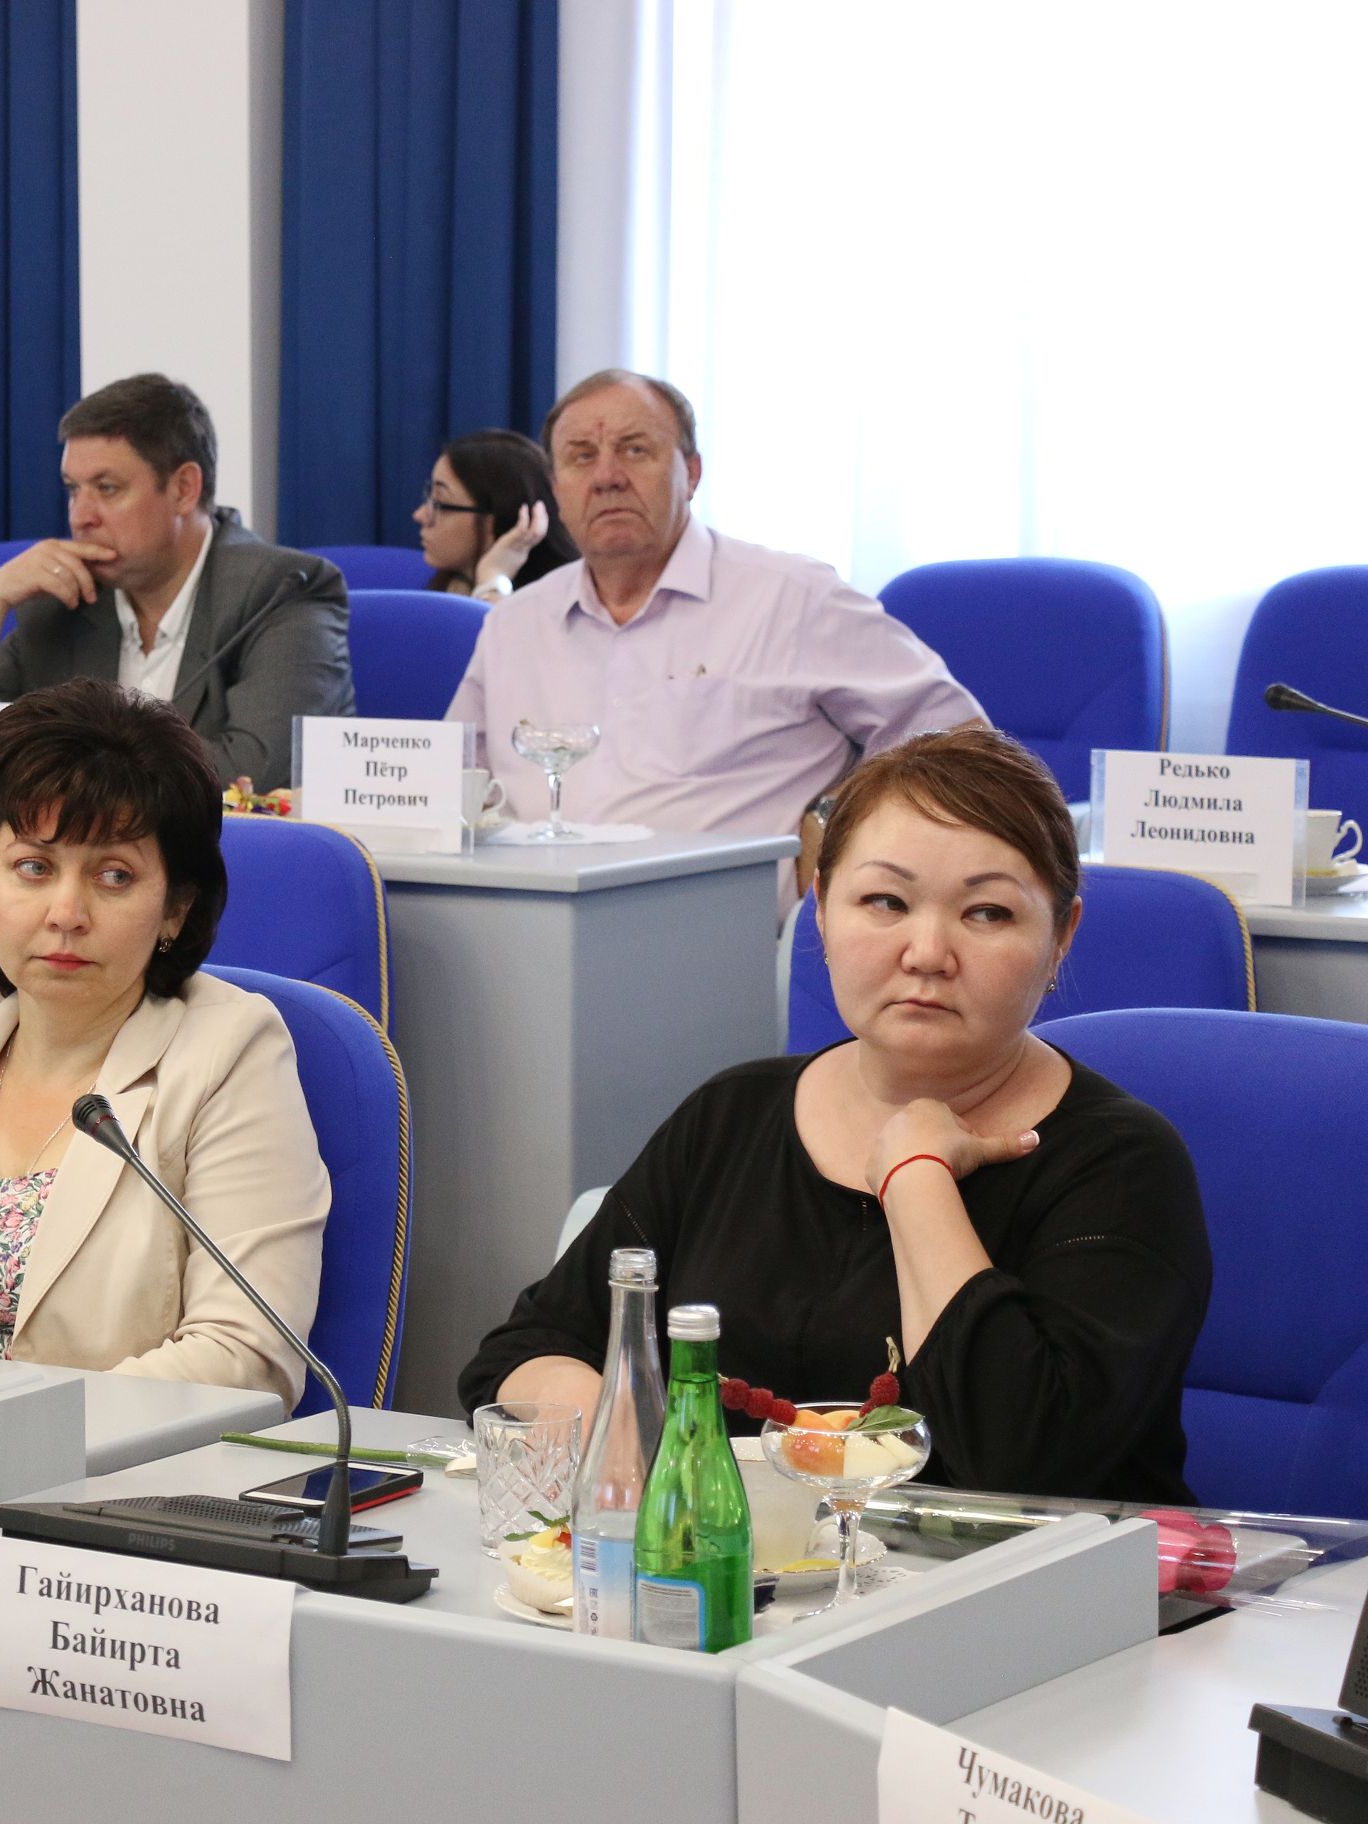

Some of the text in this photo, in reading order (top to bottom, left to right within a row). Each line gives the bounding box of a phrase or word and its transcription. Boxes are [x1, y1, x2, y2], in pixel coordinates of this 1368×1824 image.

[343, 731, 432, 752] Марченко
[365, 760, 408, 781] Пётр
[1159, 758, 1231, 780] Редько
[344, 788, 429, 809] Петрович
[1144, 789, 1243, 812] Людмила
[1130, 820, 1256, 845] Леонидовна
[128, 1532, 177, 1552] PHILIPS
[16, 1564, 221, 1625] Гайирханова
[49, 1619, 181, 1671] Байирта
[27, 1665, 207, 1723] Жанатовна
[958, 1745, 1085, 1824] Чумакова
